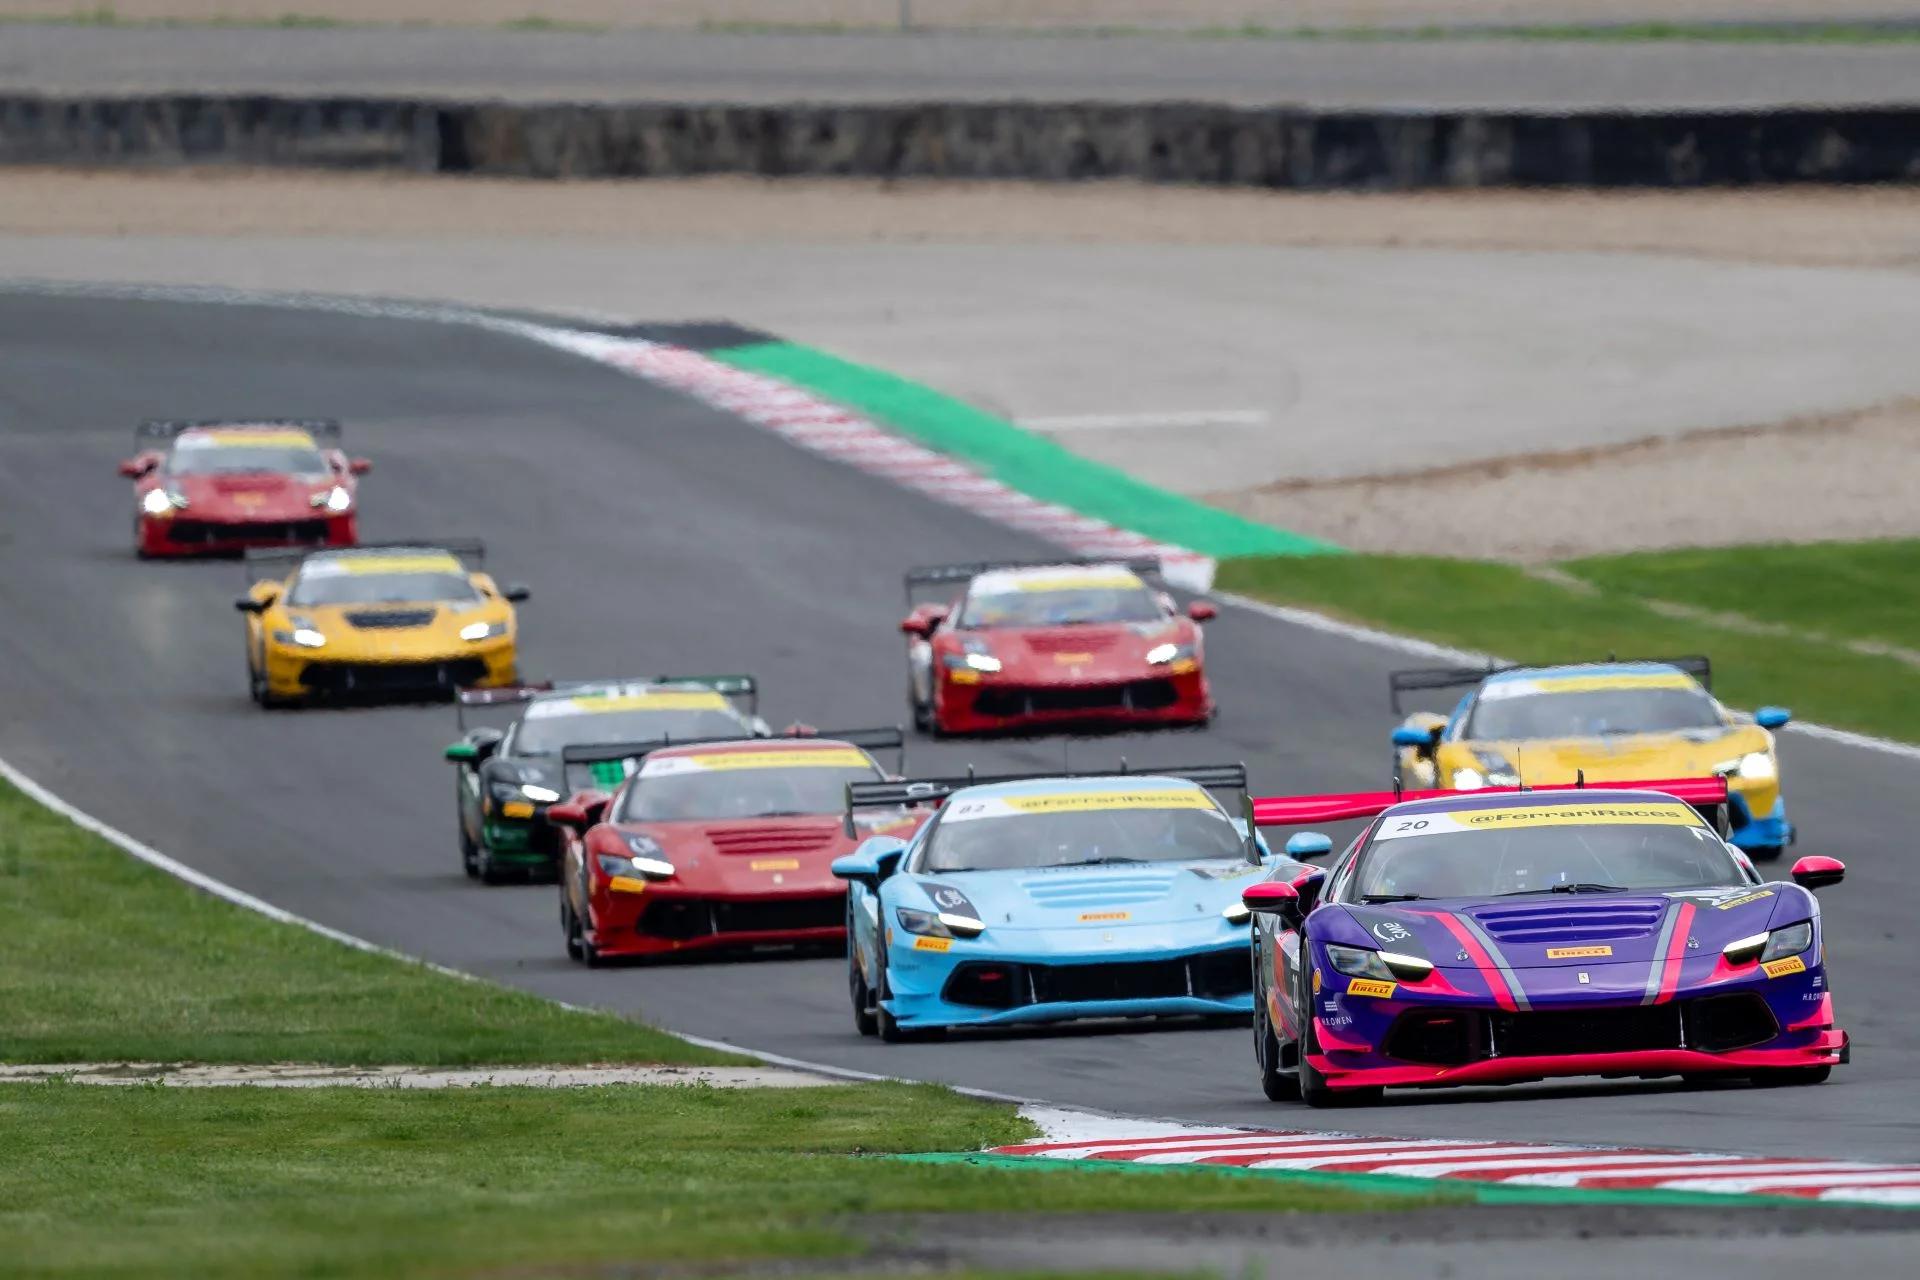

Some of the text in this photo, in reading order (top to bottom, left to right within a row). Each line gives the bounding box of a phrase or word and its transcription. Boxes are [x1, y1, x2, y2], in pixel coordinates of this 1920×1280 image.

[1470, 807, 1681, 824] @FerrariRaces
[1396, 820, 1430, 832] 20
[1383, 922, 1411, 939] aws
[1553, 947, 1606, 956] PIRELLI
[1767, 959, 1802, 974] PIRELLI
[1351, 982, 1391, 994] PIRELLI
